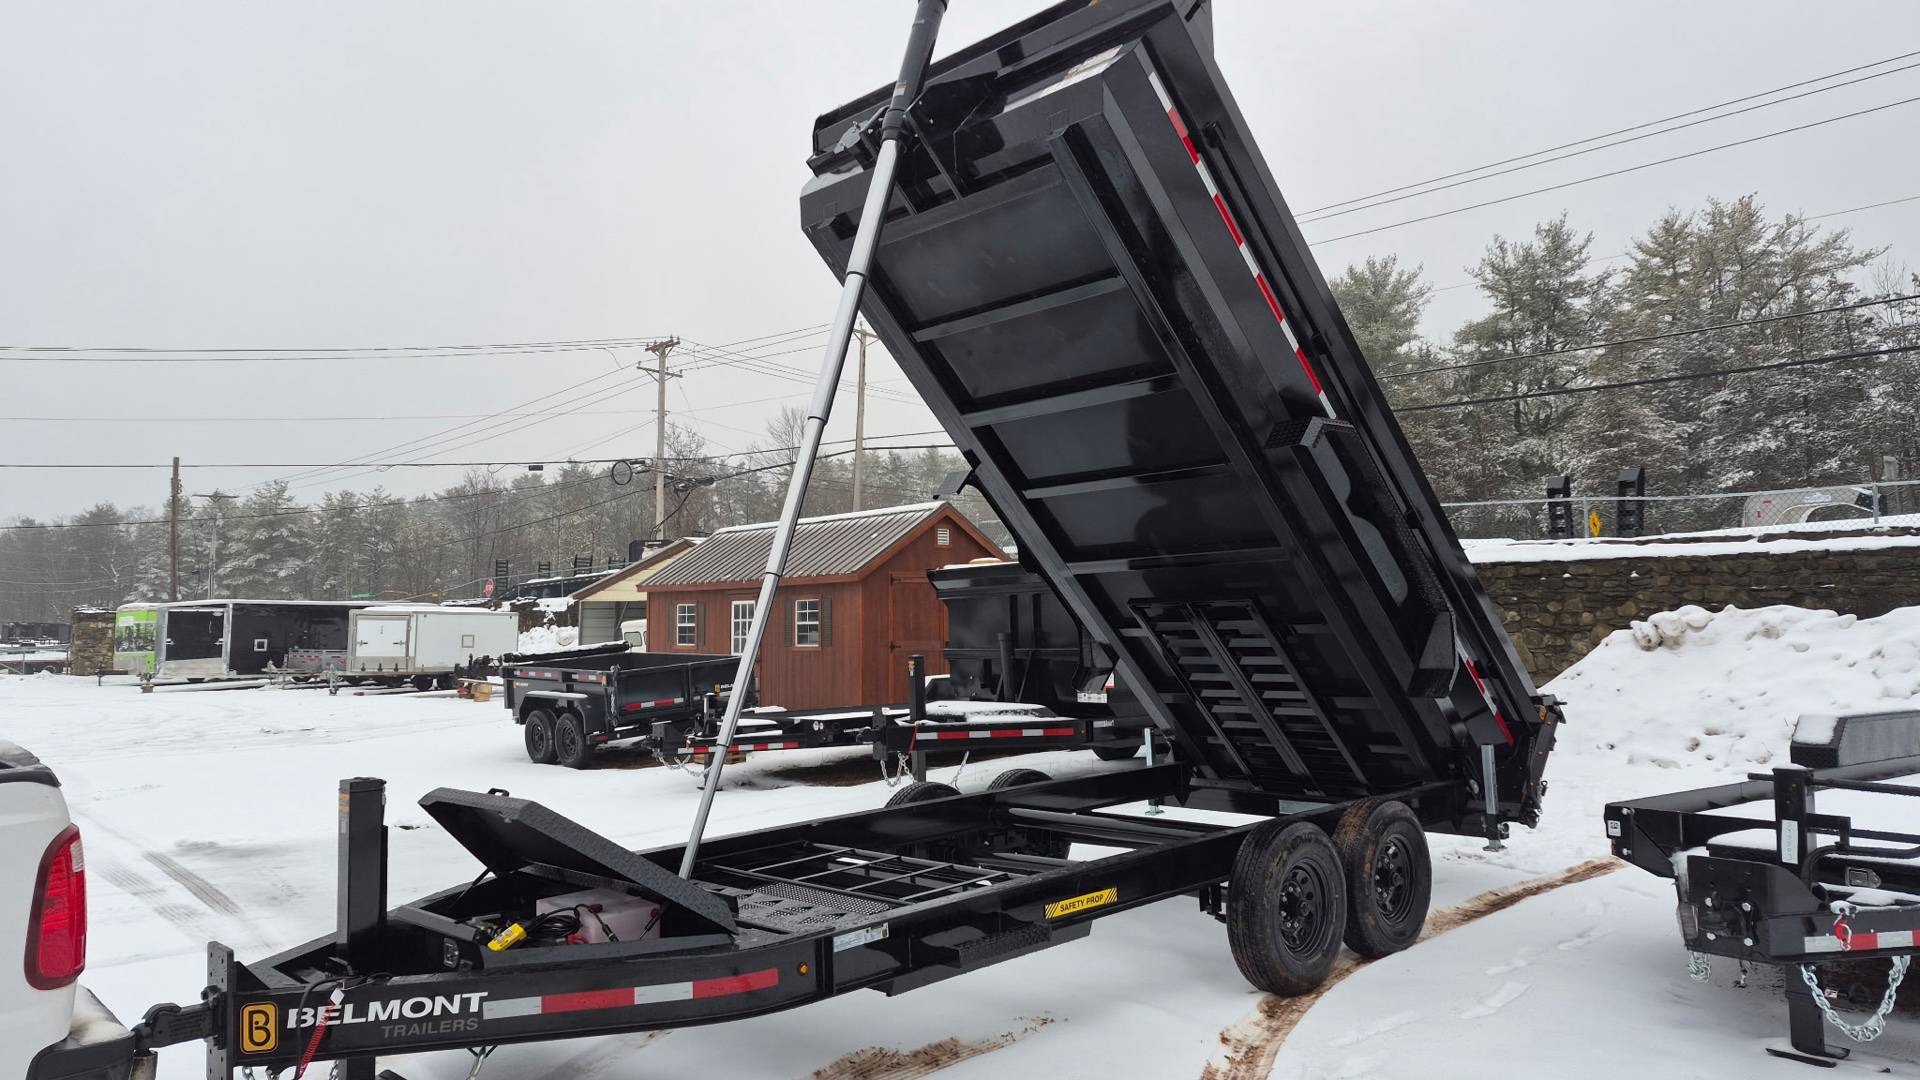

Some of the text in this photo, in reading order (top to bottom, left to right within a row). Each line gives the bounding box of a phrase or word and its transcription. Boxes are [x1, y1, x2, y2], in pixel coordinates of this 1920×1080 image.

[1060, 894, 1104, 912] SAFETY PROP
[287, 991, 489, 1029] BELMONT
[381, 1017, 479, 1039] TRAILERS
